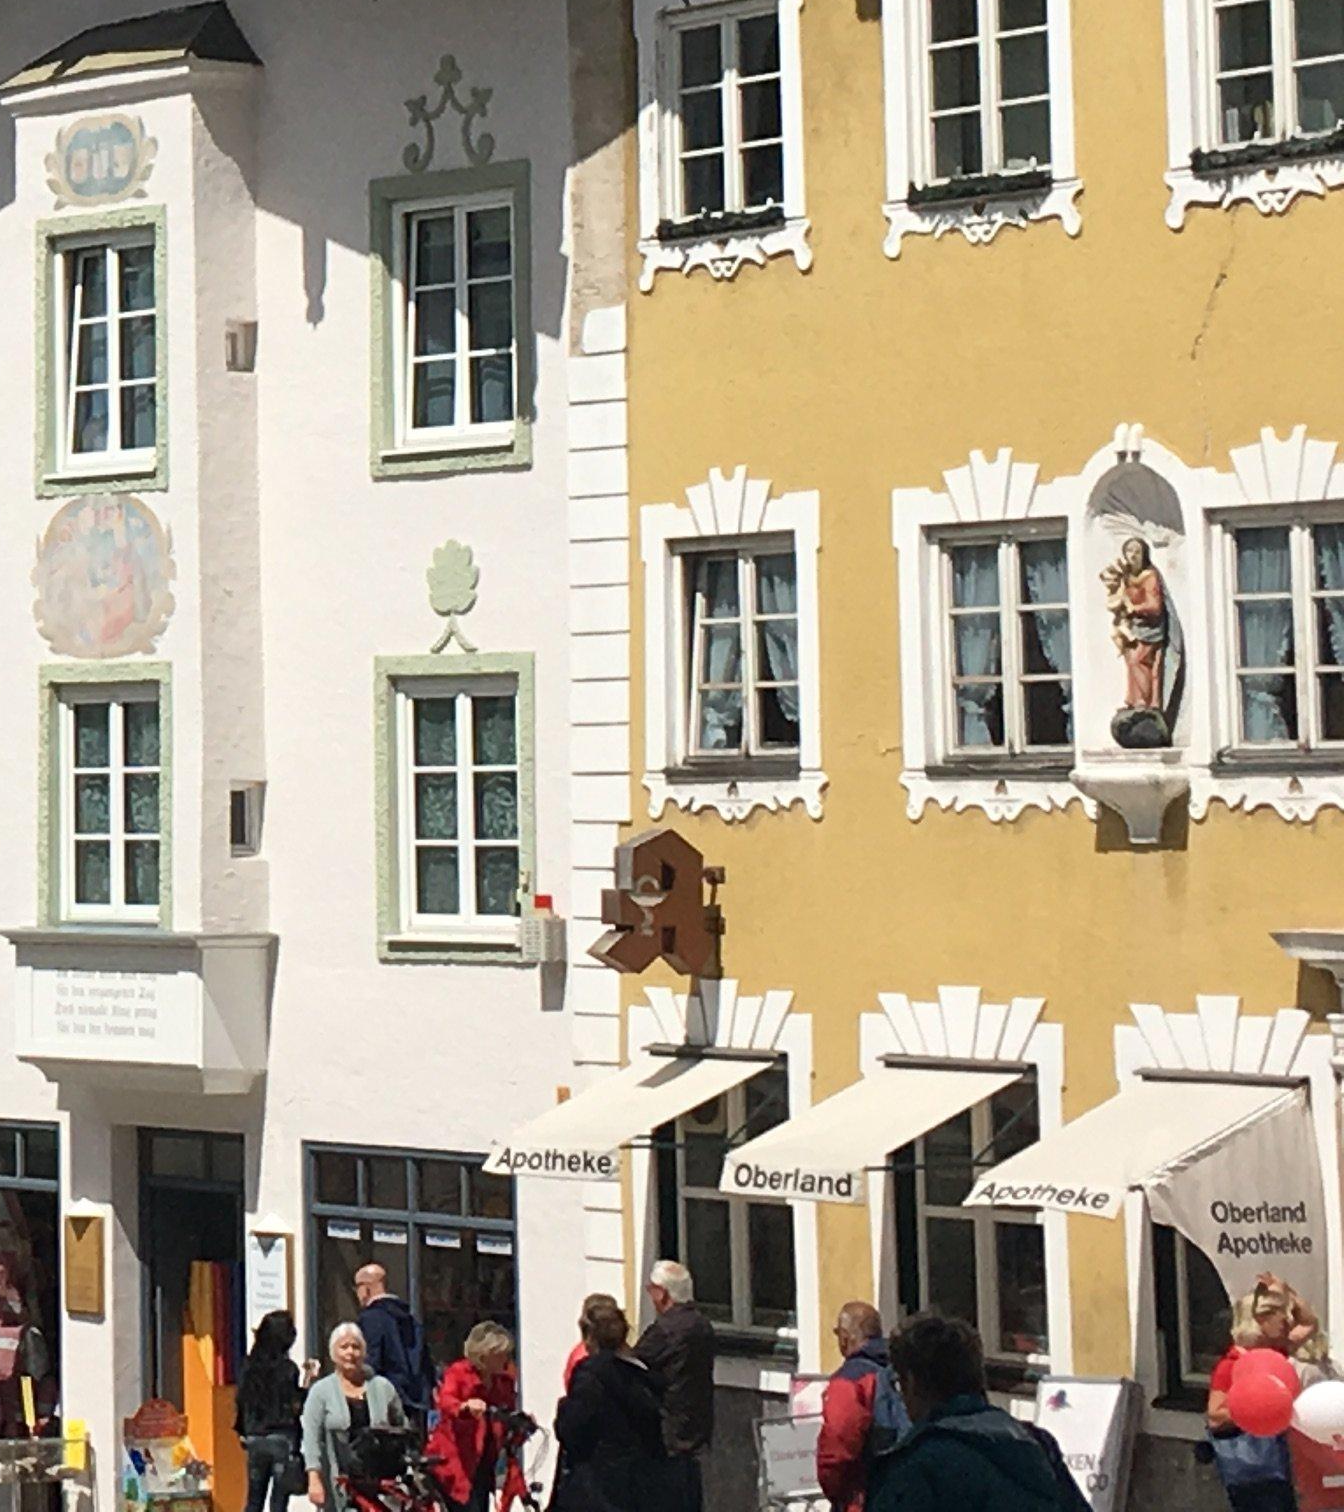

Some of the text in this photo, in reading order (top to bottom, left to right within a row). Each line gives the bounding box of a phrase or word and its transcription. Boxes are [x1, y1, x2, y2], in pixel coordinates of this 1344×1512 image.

[495, 1146, 612, 1174] Apotheke
[734, 1163, 852, 1196] Oberland
[975, 1181, 1110, 1209] Apotheke
[1210, 1200, 1307, 1223] Oberland
[1217, 1231, 1313, 1258] Apotheke
